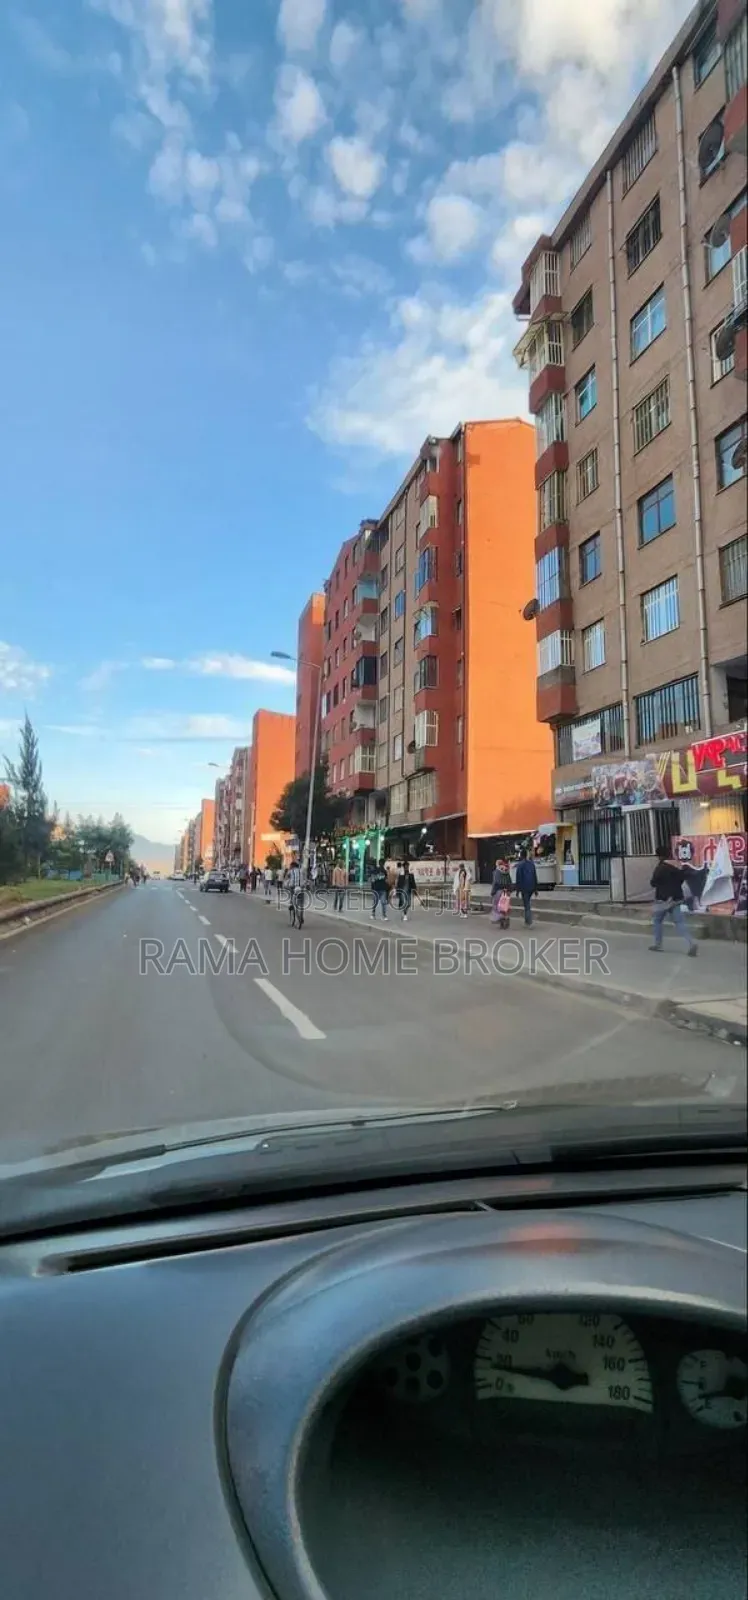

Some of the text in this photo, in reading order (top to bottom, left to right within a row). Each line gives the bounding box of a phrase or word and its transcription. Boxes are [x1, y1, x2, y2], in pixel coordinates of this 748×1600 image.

[502, 1329, 519, 1342] 40
[593, 1335, 615, 1348] 140
[603, 1356, 625, 1371] 160
[609, 1386, 630, 1400] 180
